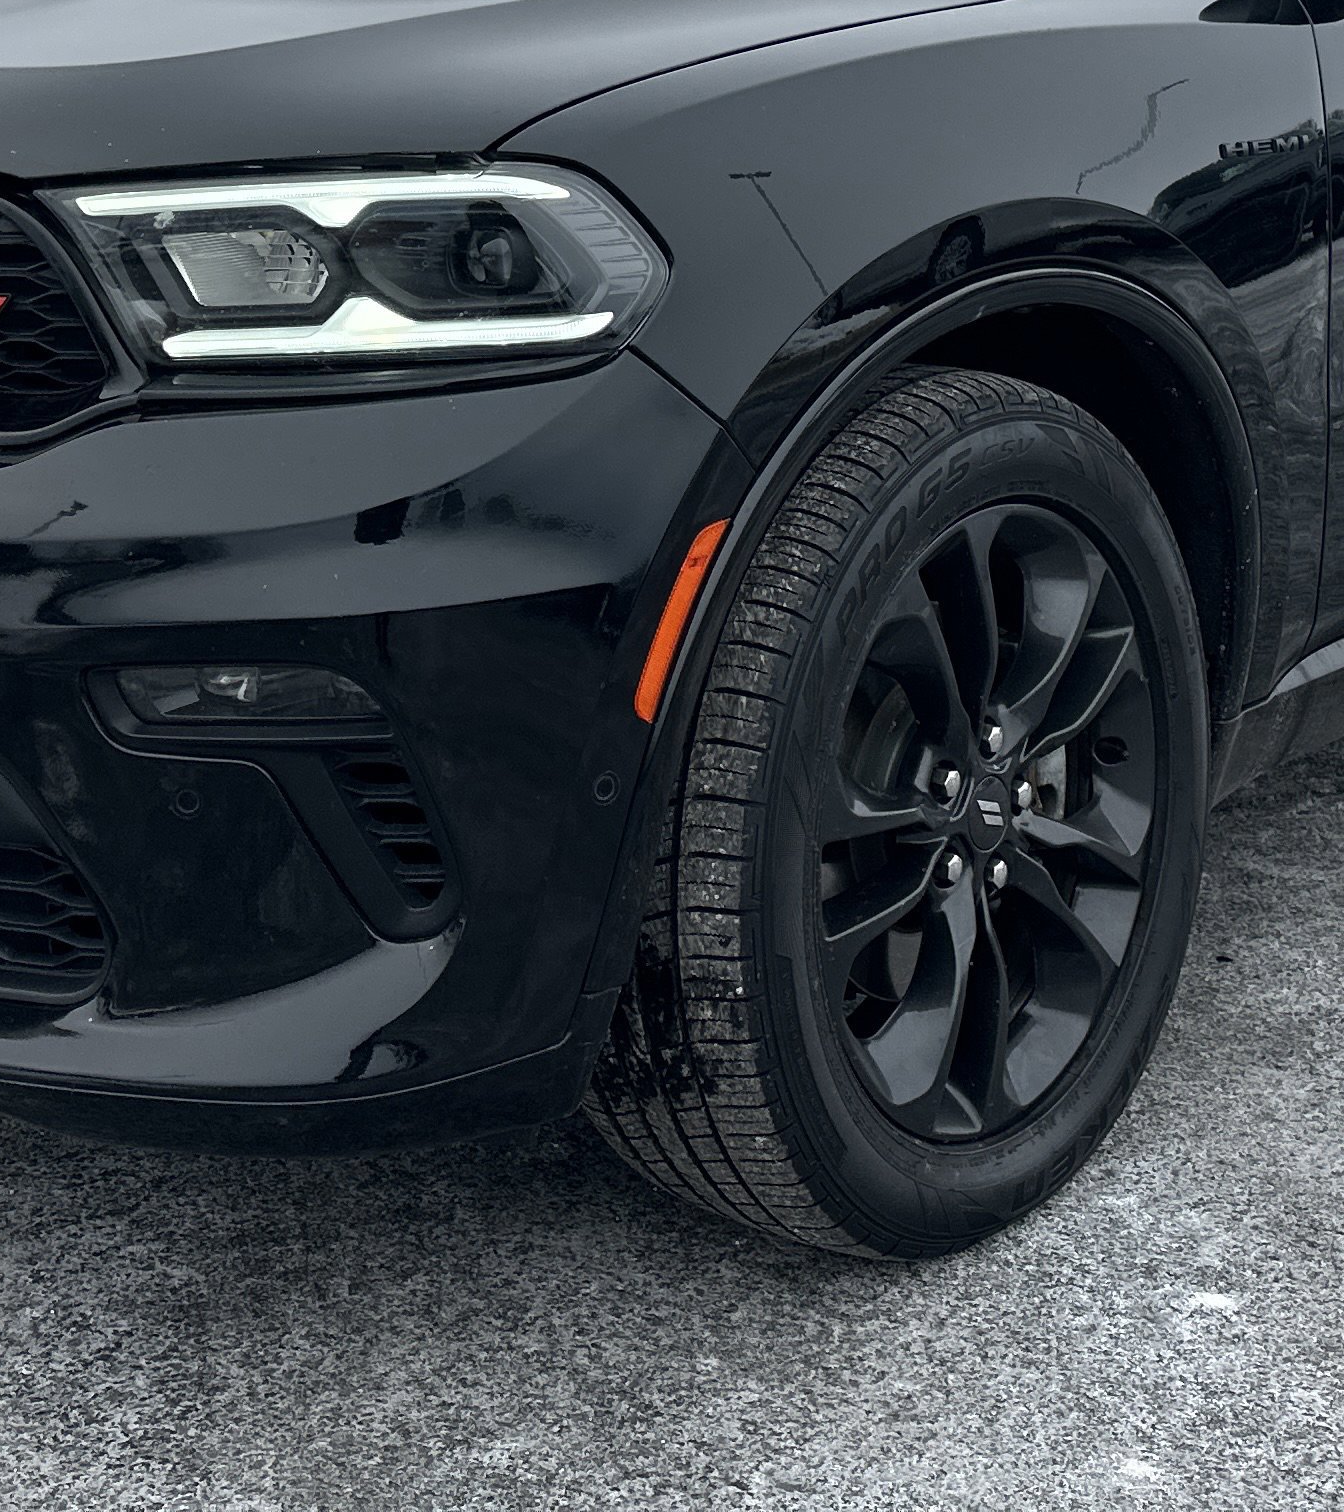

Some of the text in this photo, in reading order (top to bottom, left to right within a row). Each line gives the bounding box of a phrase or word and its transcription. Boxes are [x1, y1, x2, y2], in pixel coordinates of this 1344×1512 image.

[1218, 135, 1309, 159] HEMI
[836, 505, 908, 646] PRO
[916, 446, 973, 519] G5
